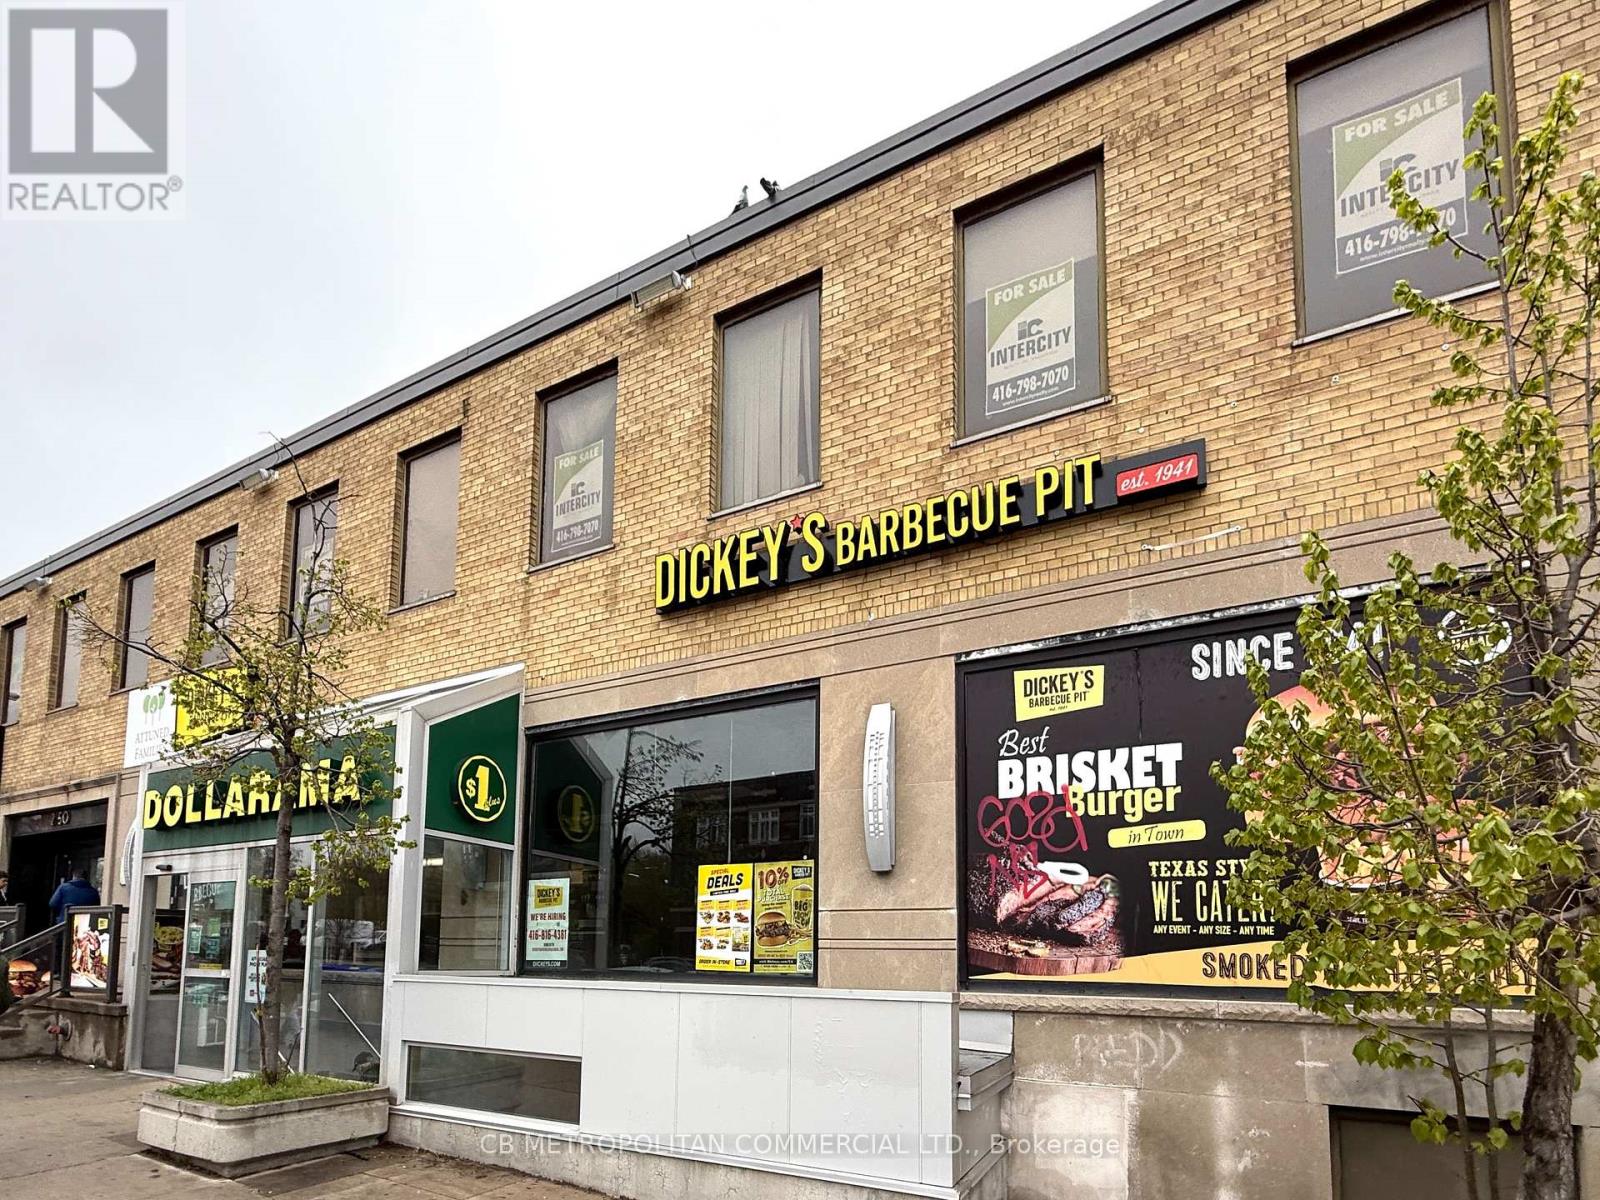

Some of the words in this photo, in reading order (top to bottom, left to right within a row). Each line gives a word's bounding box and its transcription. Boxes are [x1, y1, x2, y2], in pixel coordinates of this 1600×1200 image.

[1344, 117, 1387, 142] FOR
[1394, 90, 1449, 126] SALE
[1340, 158, 1459, 218] INTECITY
[1344, 208, 1456, 257] 416-798-70
[993, 283, 1024, 306] FOR
[1029, 268, 1066, 294] SALE
[990, 326, 1072, 368] INTERCITY
[992, 364, 1069, 402] 416-798-7070
[560, 455, 577, 470] FOR
[579, 446, 600, 464] SALE
[555, 489, 600, 516] INTERCITY
[836, 474, 1021, 567] BARBECUE
[1034, 452, 1102, 517] PIT
[1121, 471, 1149, 491] est.
[1155, 458, 1194, 483] 1941
[1191, 631, 1295, 681] SINCE
[1023, 669, 1095, 698] DICKEY'S
[1028, 693, 1072, 708] BARBECUE
[1073, 691, 1088, 702] PIT
[134, 726, 170, 745] ATTUNED
[997, 726, 1050, 757] Best
[997, 742, 1183, 799] BRISKET
[143, 755, 361, 829] DOLLARMA
[1066, 784, 1182, 823] Burger
[1128, 828, 1143, 844] in
[1145, 825, 1184, 842] Town
[706, 872, 744, 889] DEALS
[758, 866, 789, 890] 10%
[1149, 860, 1209, 877] TEXAS
[1215, 858, 1252, 877] STY
[531, 912, 547, 921] WE'RE
[547, 912, 567, 921] HIRING
[1151, 880, 1183, 922] WE
[1153, 925, 1168, 934] ANY
[1168, 925, 1191, 934] EVENT
[1199, 926, 1213, 935] ANY
[1215, 926, 1231, 935] SIZE
[1239, 926, 1254, 935] ANY
[1256, 926, 1275, 935] TIME
[1202, 951, 1308, 981] SMOKED
